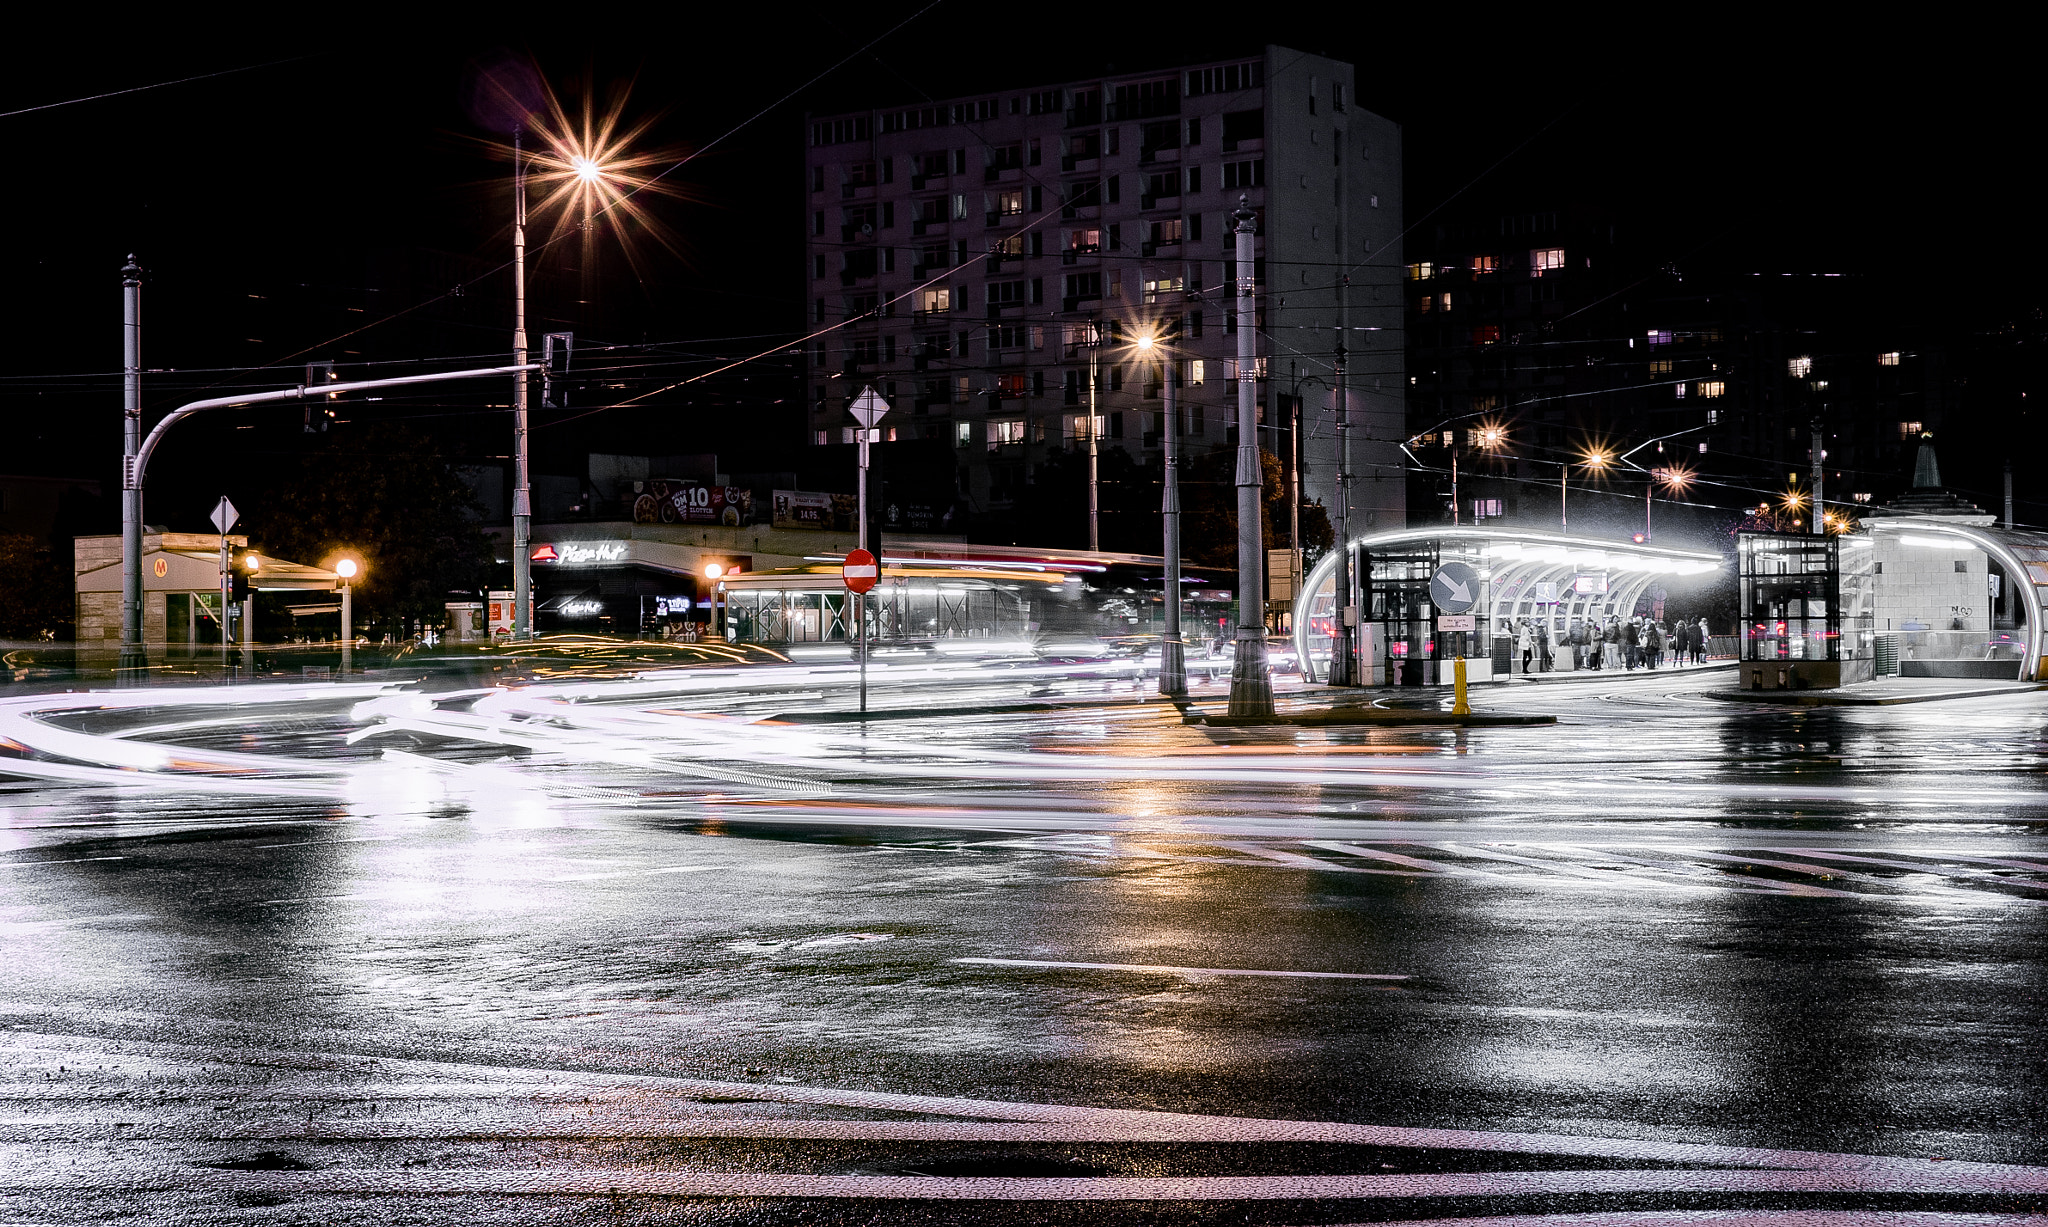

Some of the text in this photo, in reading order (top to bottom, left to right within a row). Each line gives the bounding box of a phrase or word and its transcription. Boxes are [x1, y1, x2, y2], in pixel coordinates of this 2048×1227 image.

[674, 494, 688, 507] OM
[689, 487, 709, 507] 10
[558, 544, 627, 564] Pizza Hut
[156, 561, 166, 573] M
